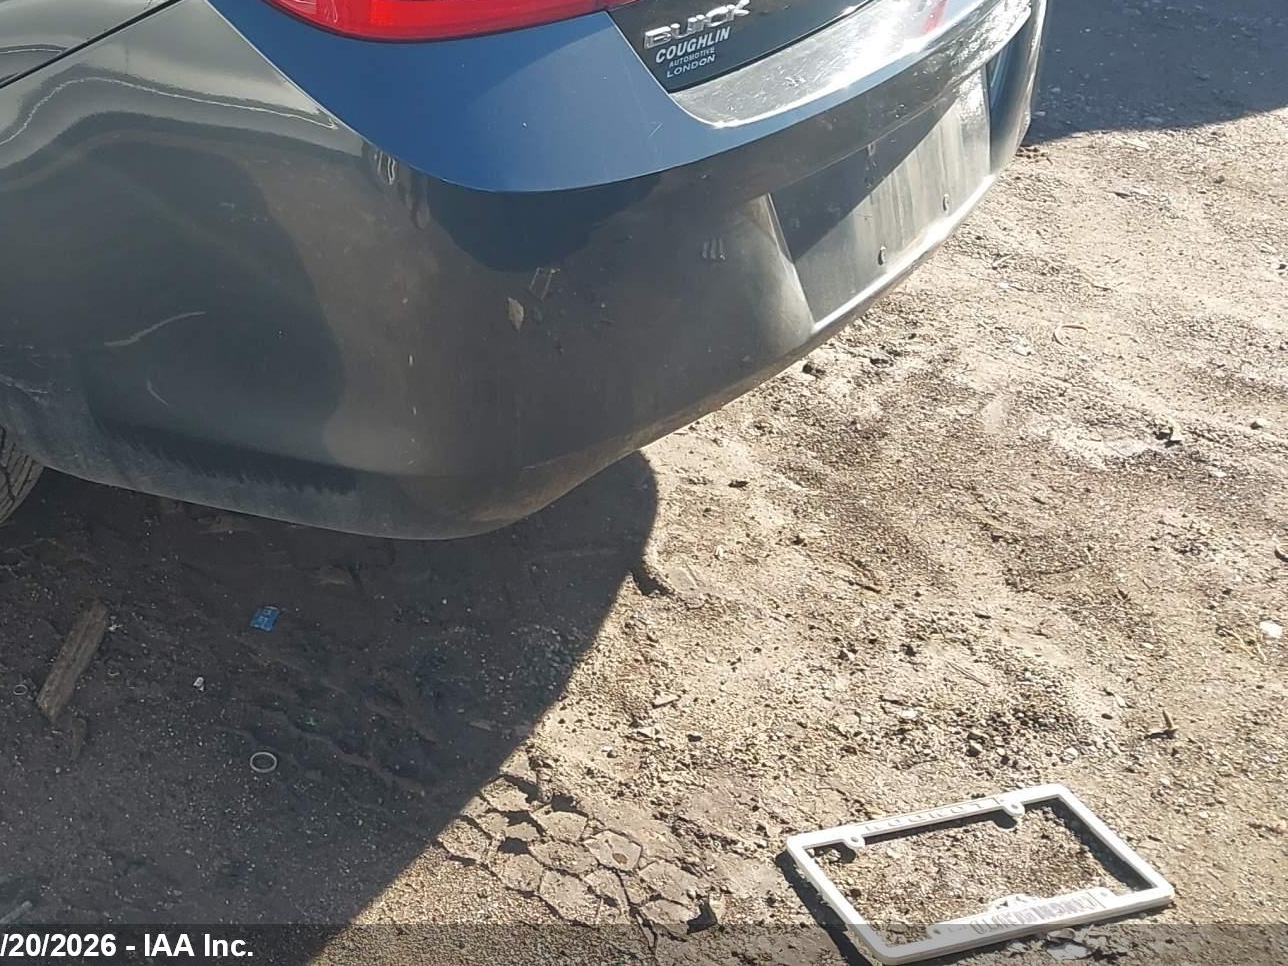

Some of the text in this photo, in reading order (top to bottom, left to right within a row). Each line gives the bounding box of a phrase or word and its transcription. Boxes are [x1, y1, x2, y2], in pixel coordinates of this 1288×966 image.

[655, 25, 731, 64] COUGHLIN
[666, 53, 716, 78] LONDON
[668, 47, 715, 68] AUTOMOTIVE
